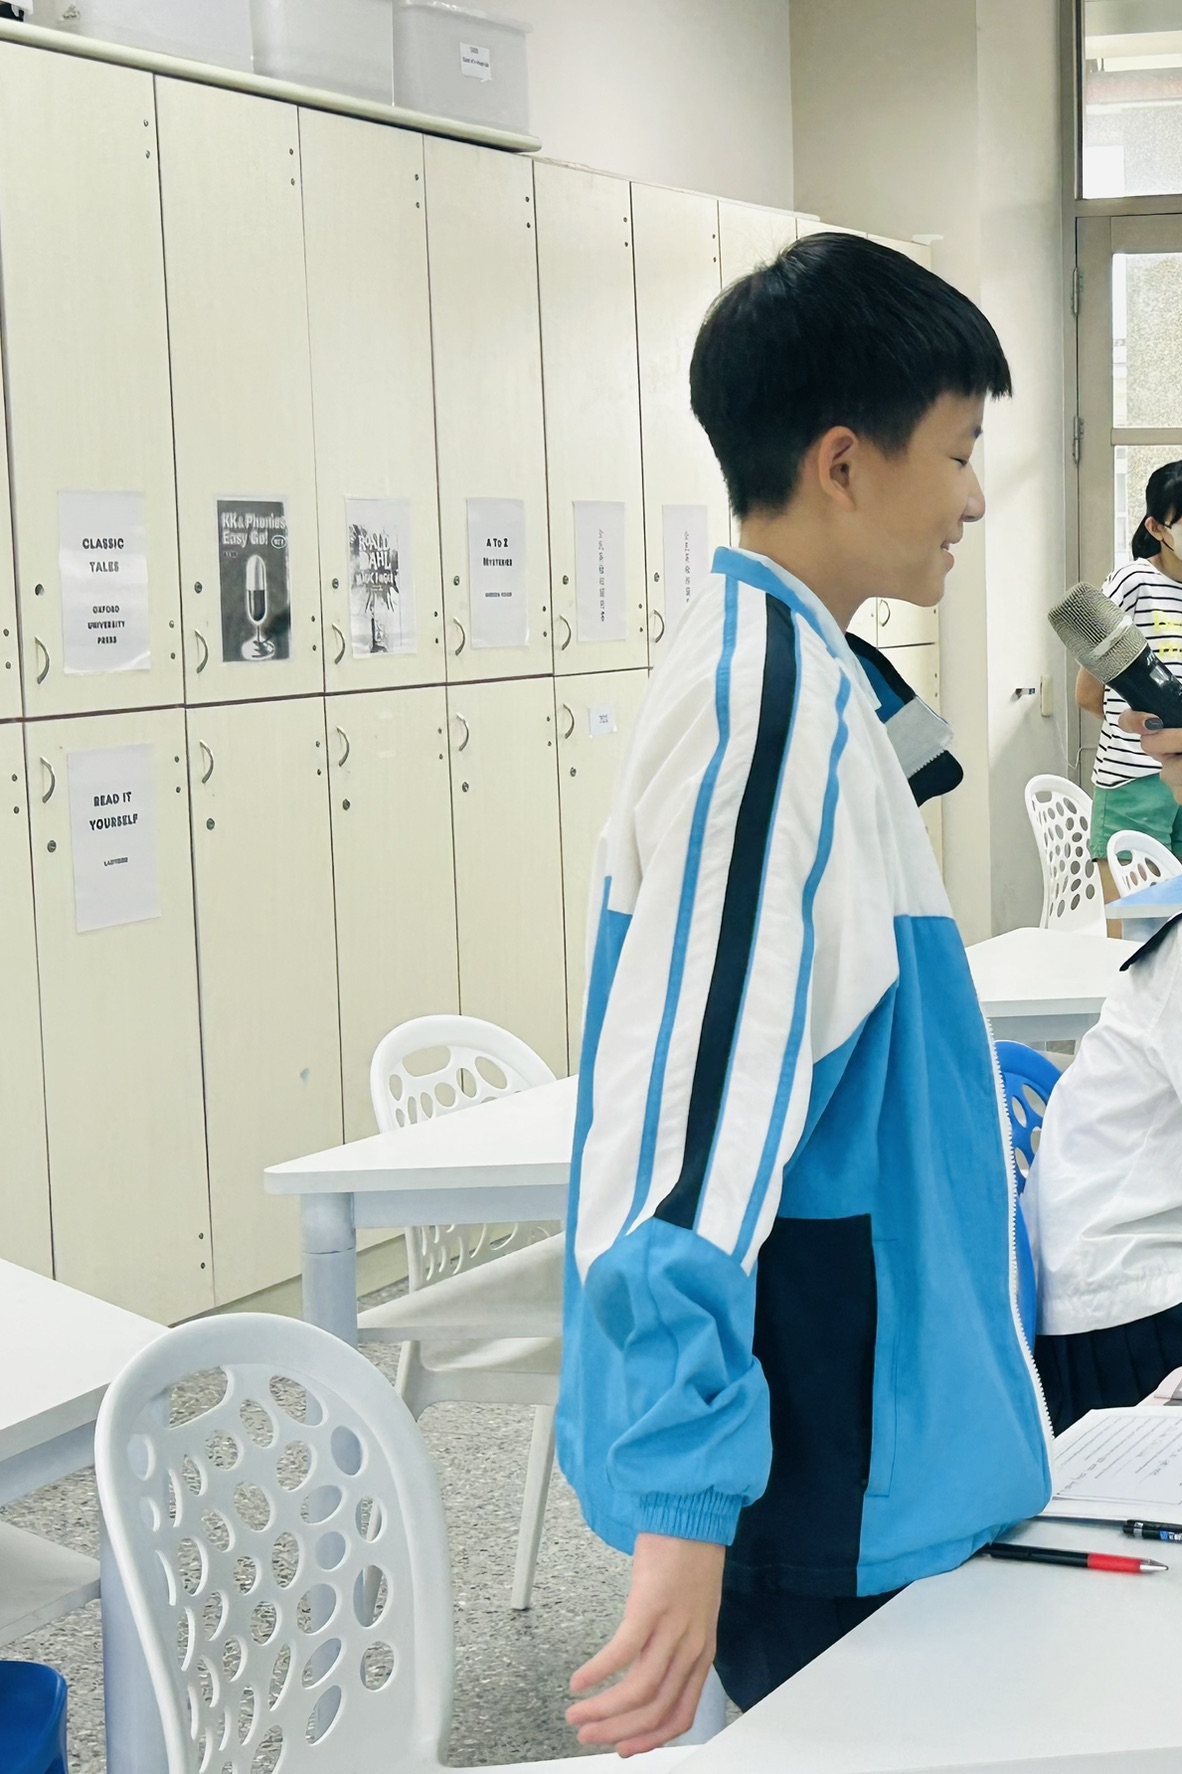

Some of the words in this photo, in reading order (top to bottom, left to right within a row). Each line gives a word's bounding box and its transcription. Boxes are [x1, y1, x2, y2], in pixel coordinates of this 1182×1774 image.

[82, 538, 124, 549] CLASSIC
[223, 530, 248, 548] Easy
[250, 529, 268, 545] Go!
[486, 538, 492, 547] A
[503, 538, 509, 547] Z
[89, 561, 119, 572] TALES
[93, 793, 120, 807] READ
[122, 791, 132, 803] IT
[89, 813, 138, 831] YOURSELF
